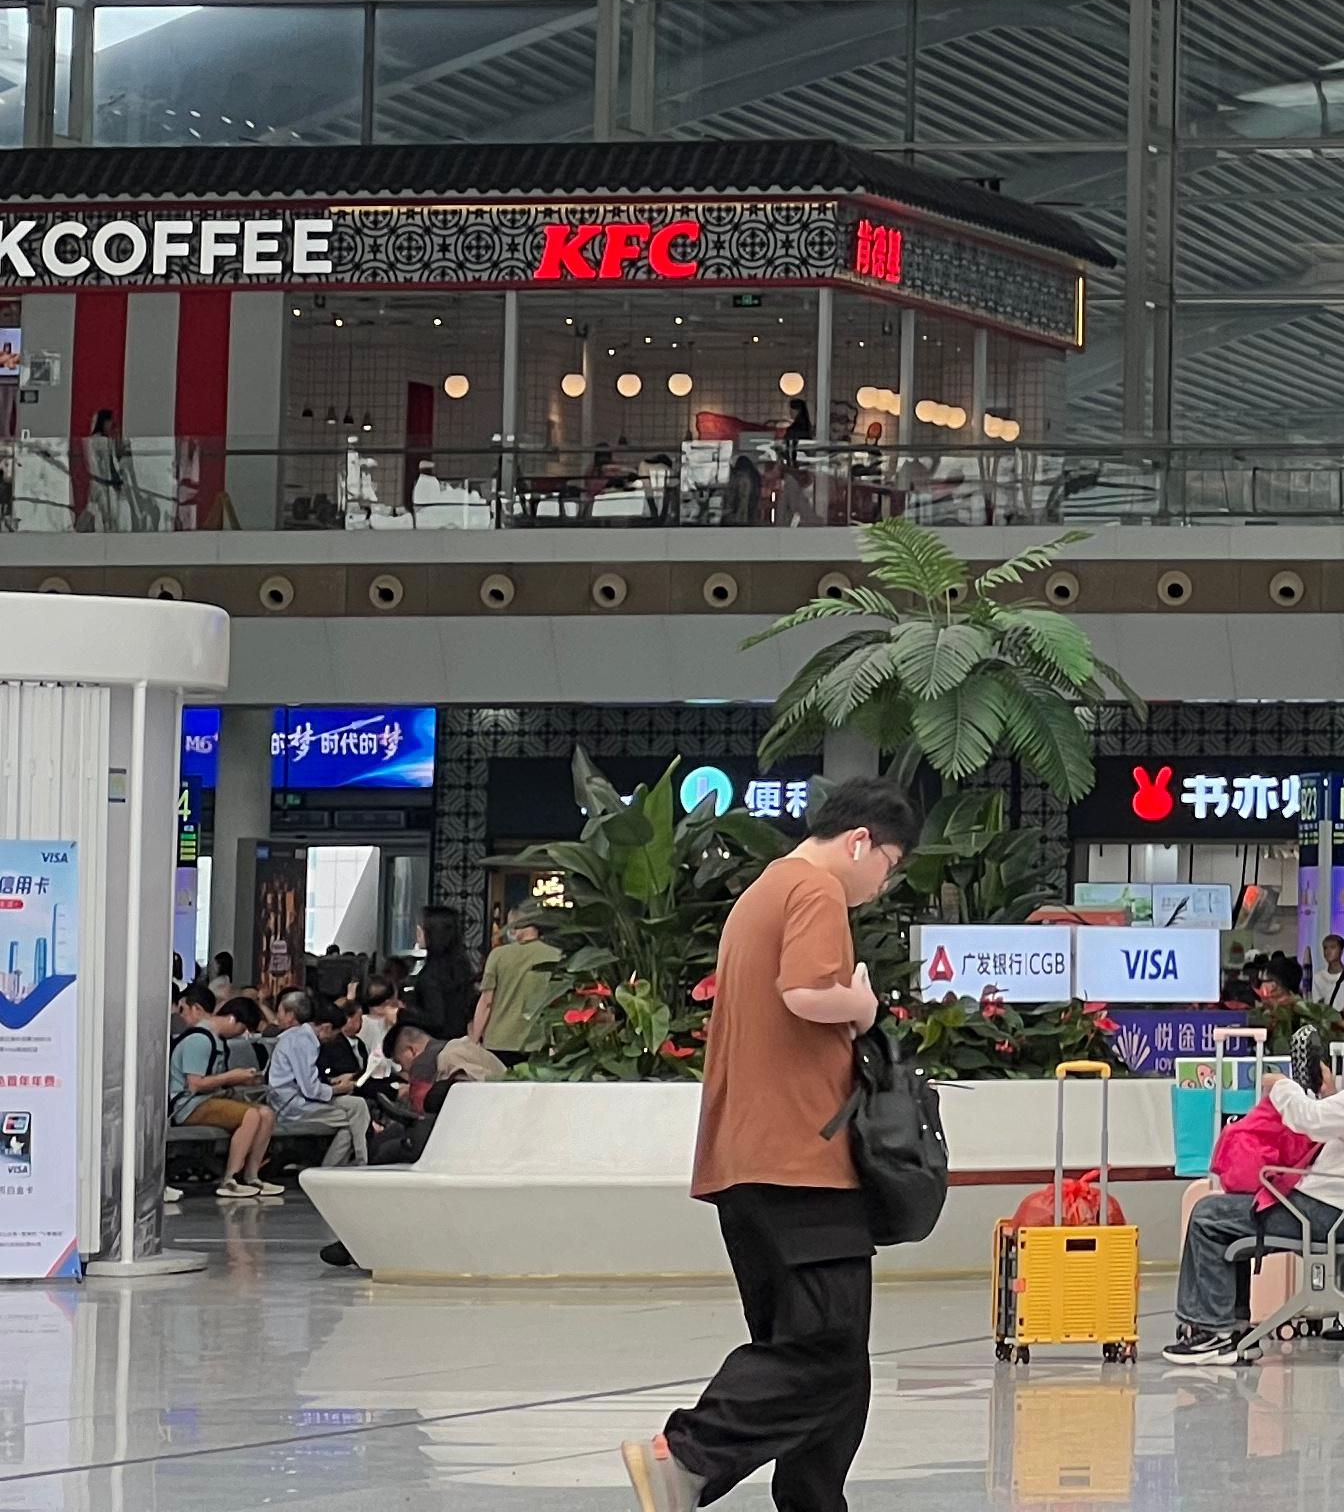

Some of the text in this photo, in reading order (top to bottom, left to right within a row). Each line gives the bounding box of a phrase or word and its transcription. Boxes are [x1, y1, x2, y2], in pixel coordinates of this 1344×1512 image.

[533, 222, 700, 279] KFC
[320, 722, 403, 761] 时代的梦
[41, 852, 68, 863] VISA
[961, 952, 1065, 976] 广发银行 CGB
[1120, 949, 1178, 980] VISA
[8, 1165, 28, 1174] VISA
